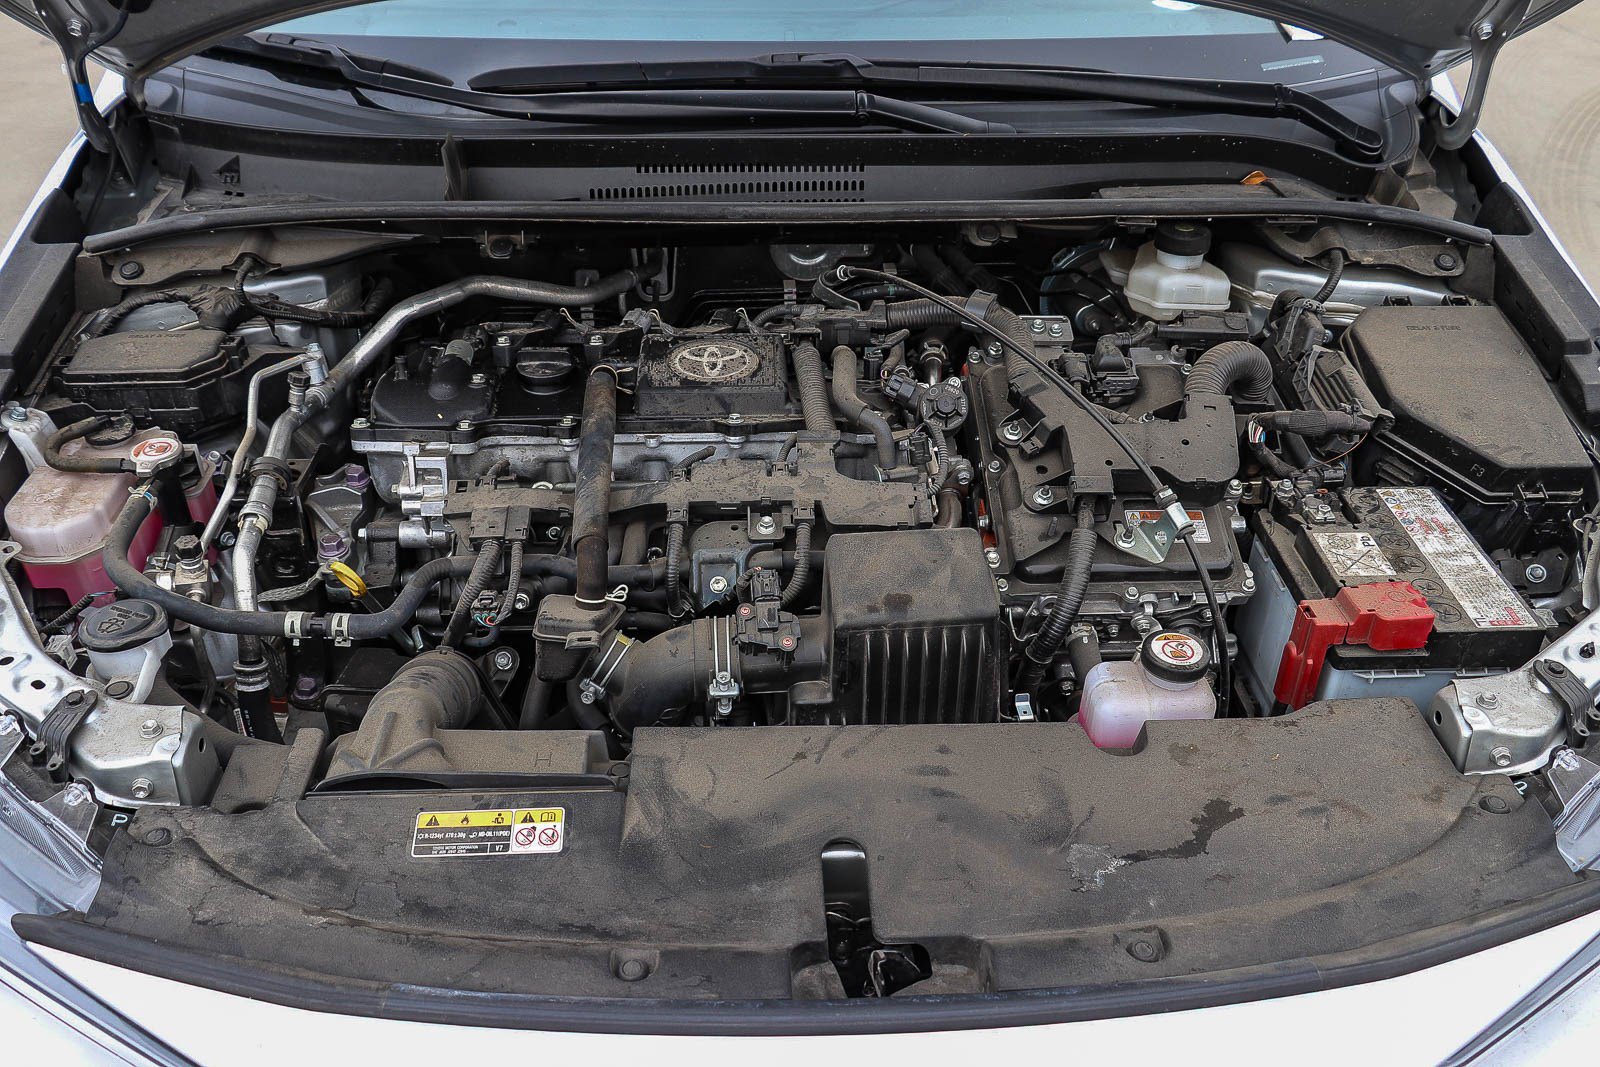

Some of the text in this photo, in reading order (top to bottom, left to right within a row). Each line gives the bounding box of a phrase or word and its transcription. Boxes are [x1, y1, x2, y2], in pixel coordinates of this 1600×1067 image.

[1470, 463, 1486, 477] F3
[1359, 535, 1376, 547] Pb
[533, 751, 553, 768] H
[110, 813, 128, 827] P
[495, 844, 504, 852] V7
